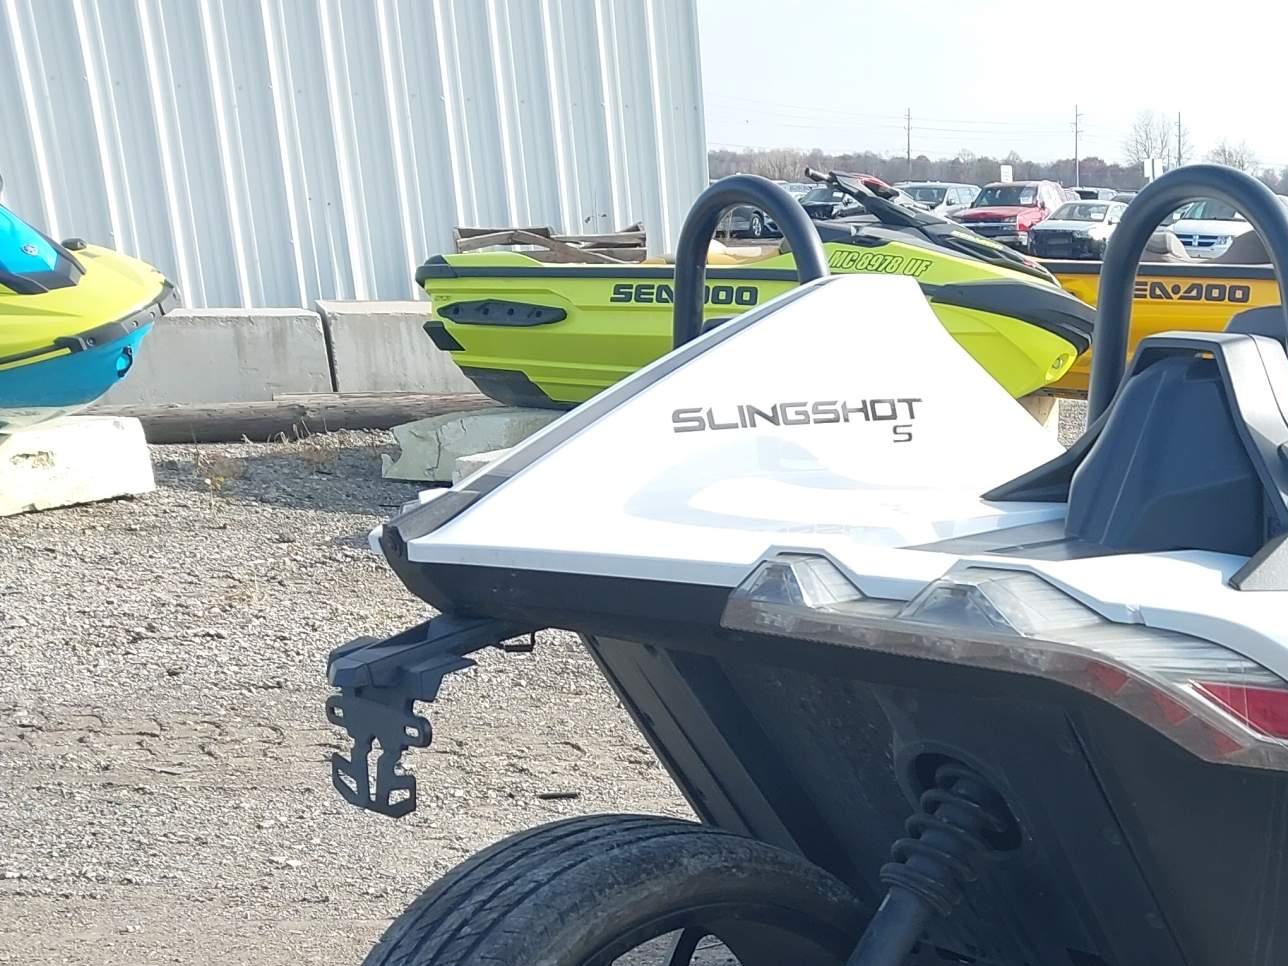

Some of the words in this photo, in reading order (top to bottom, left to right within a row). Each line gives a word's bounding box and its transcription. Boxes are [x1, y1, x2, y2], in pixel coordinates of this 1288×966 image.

[829, 250, 857, 269] MC
[856, 252, 903, 274] 8978
[902, 258, 932, 278] UF
[671, 398, 923, 433] SLINGSHOT
[892, 424, 913, 443] S
